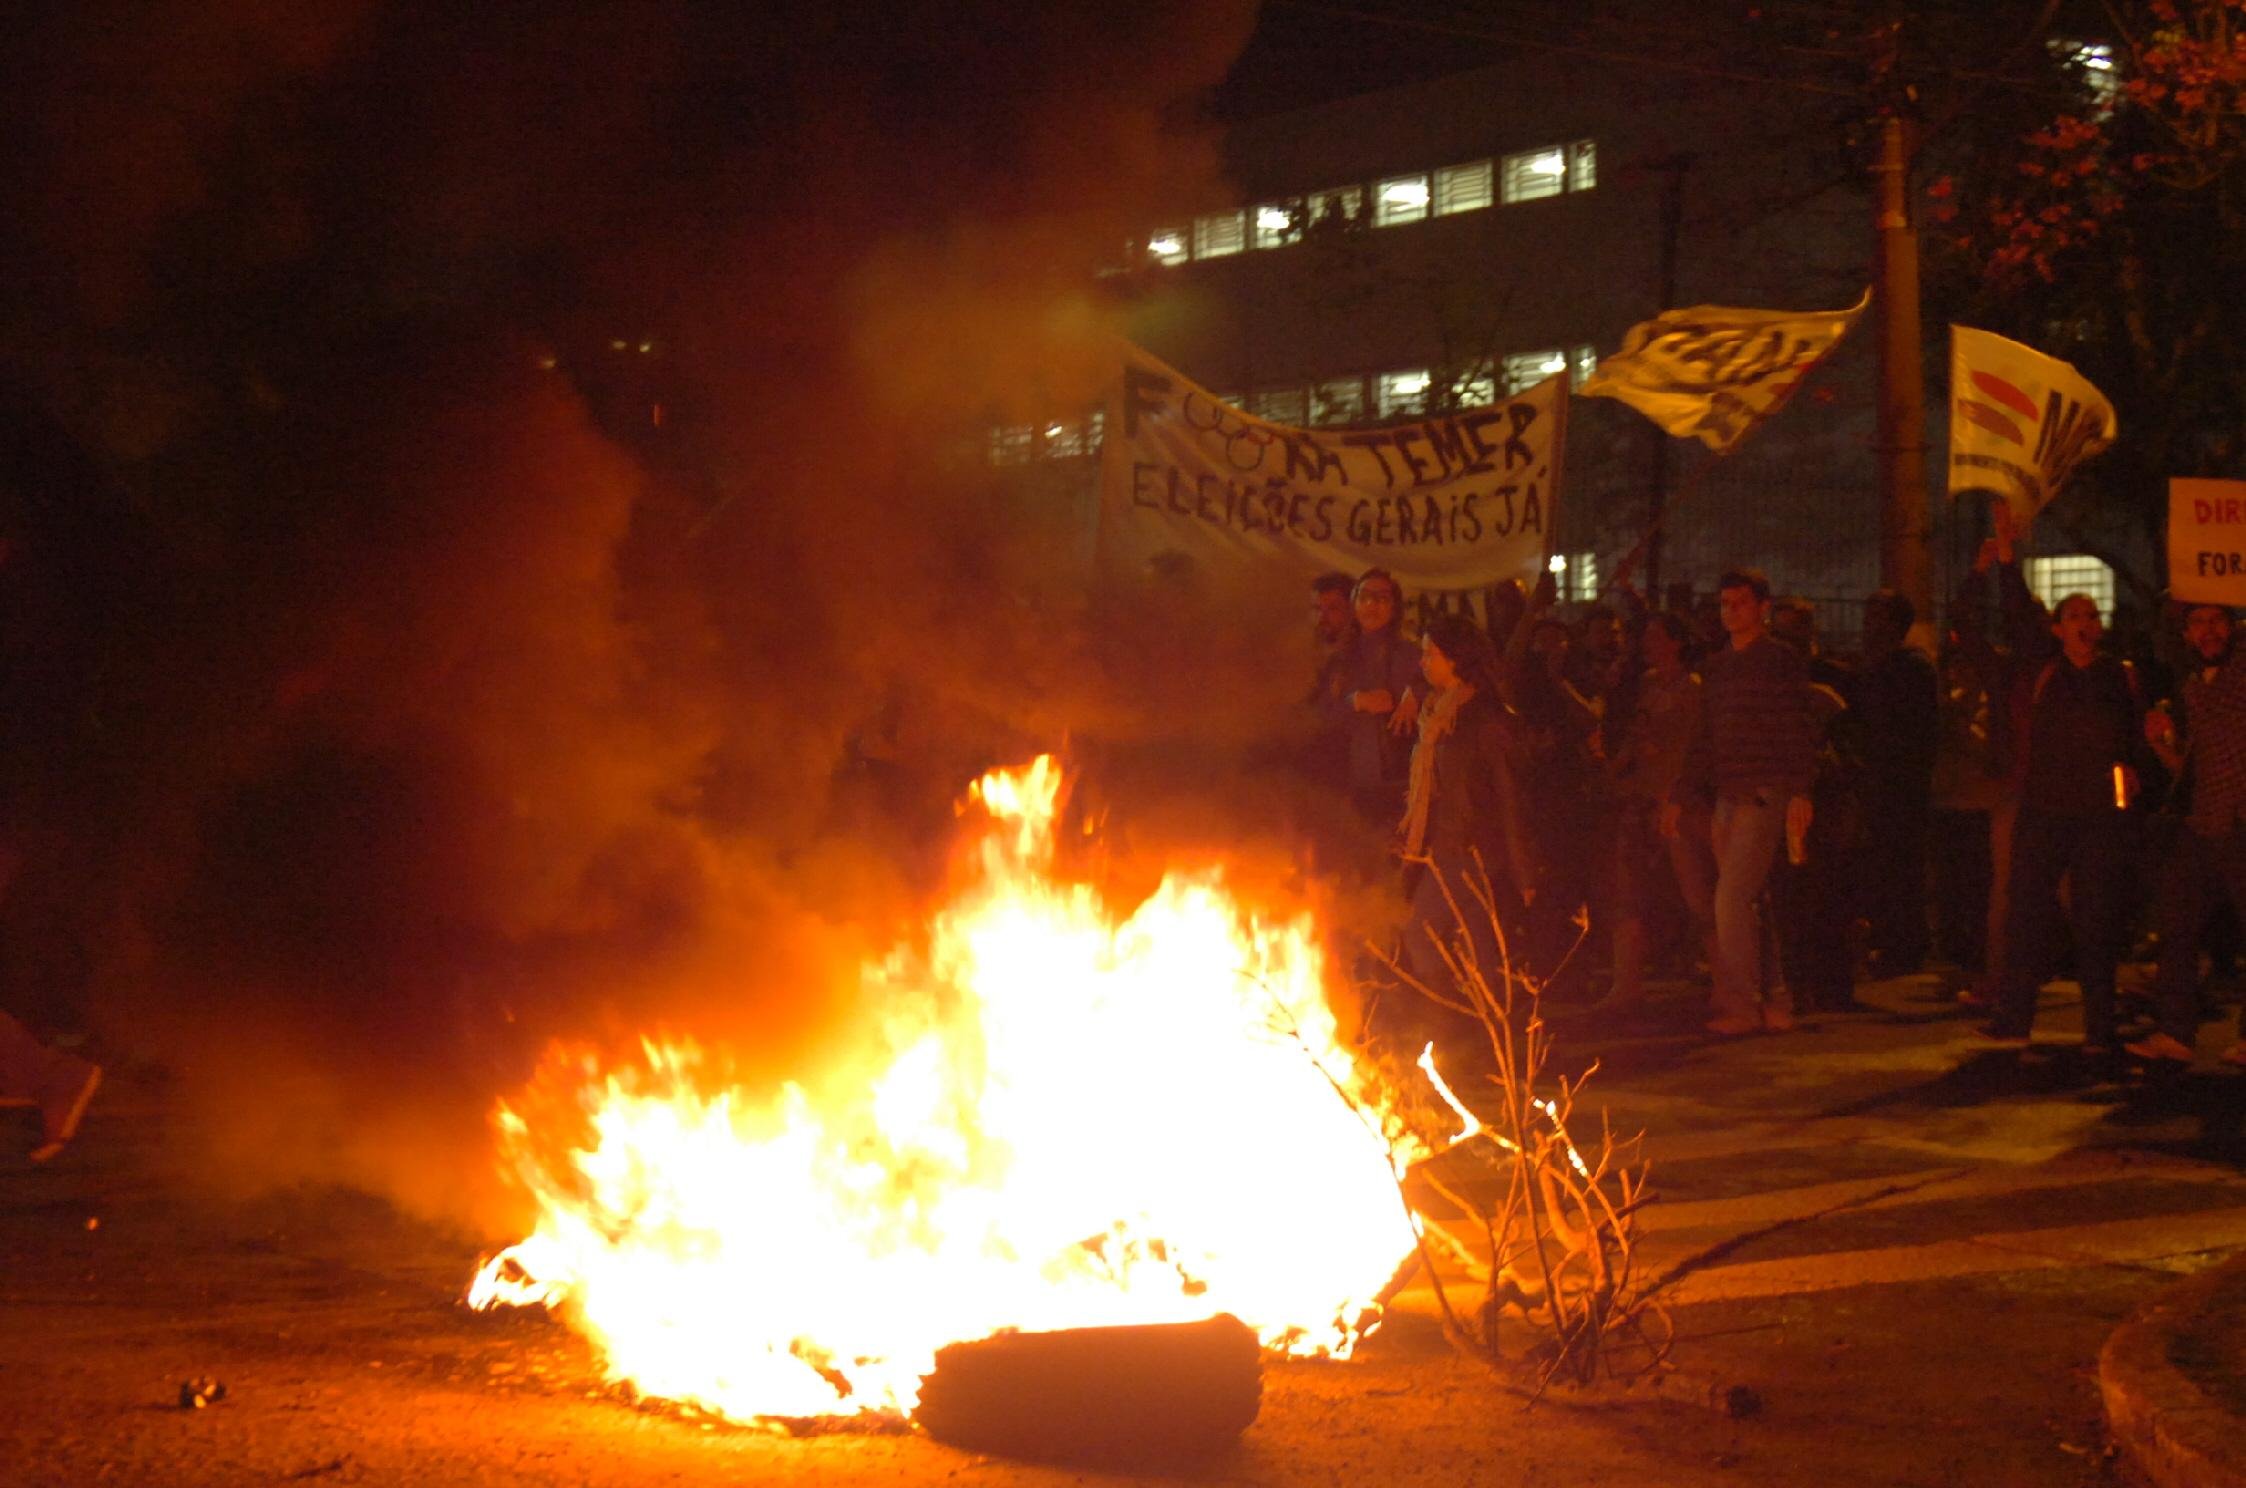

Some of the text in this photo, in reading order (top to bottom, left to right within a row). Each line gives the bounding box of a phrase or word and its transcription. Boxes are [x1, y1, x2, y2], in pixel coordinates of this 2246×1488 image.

[1343, 402, 1537, 488] TEMER
[1496, 465, 1547, 537] JÁ
[2193, 497, 2246, 525] DIR
[2197, 551, 2246, 577] FOR
